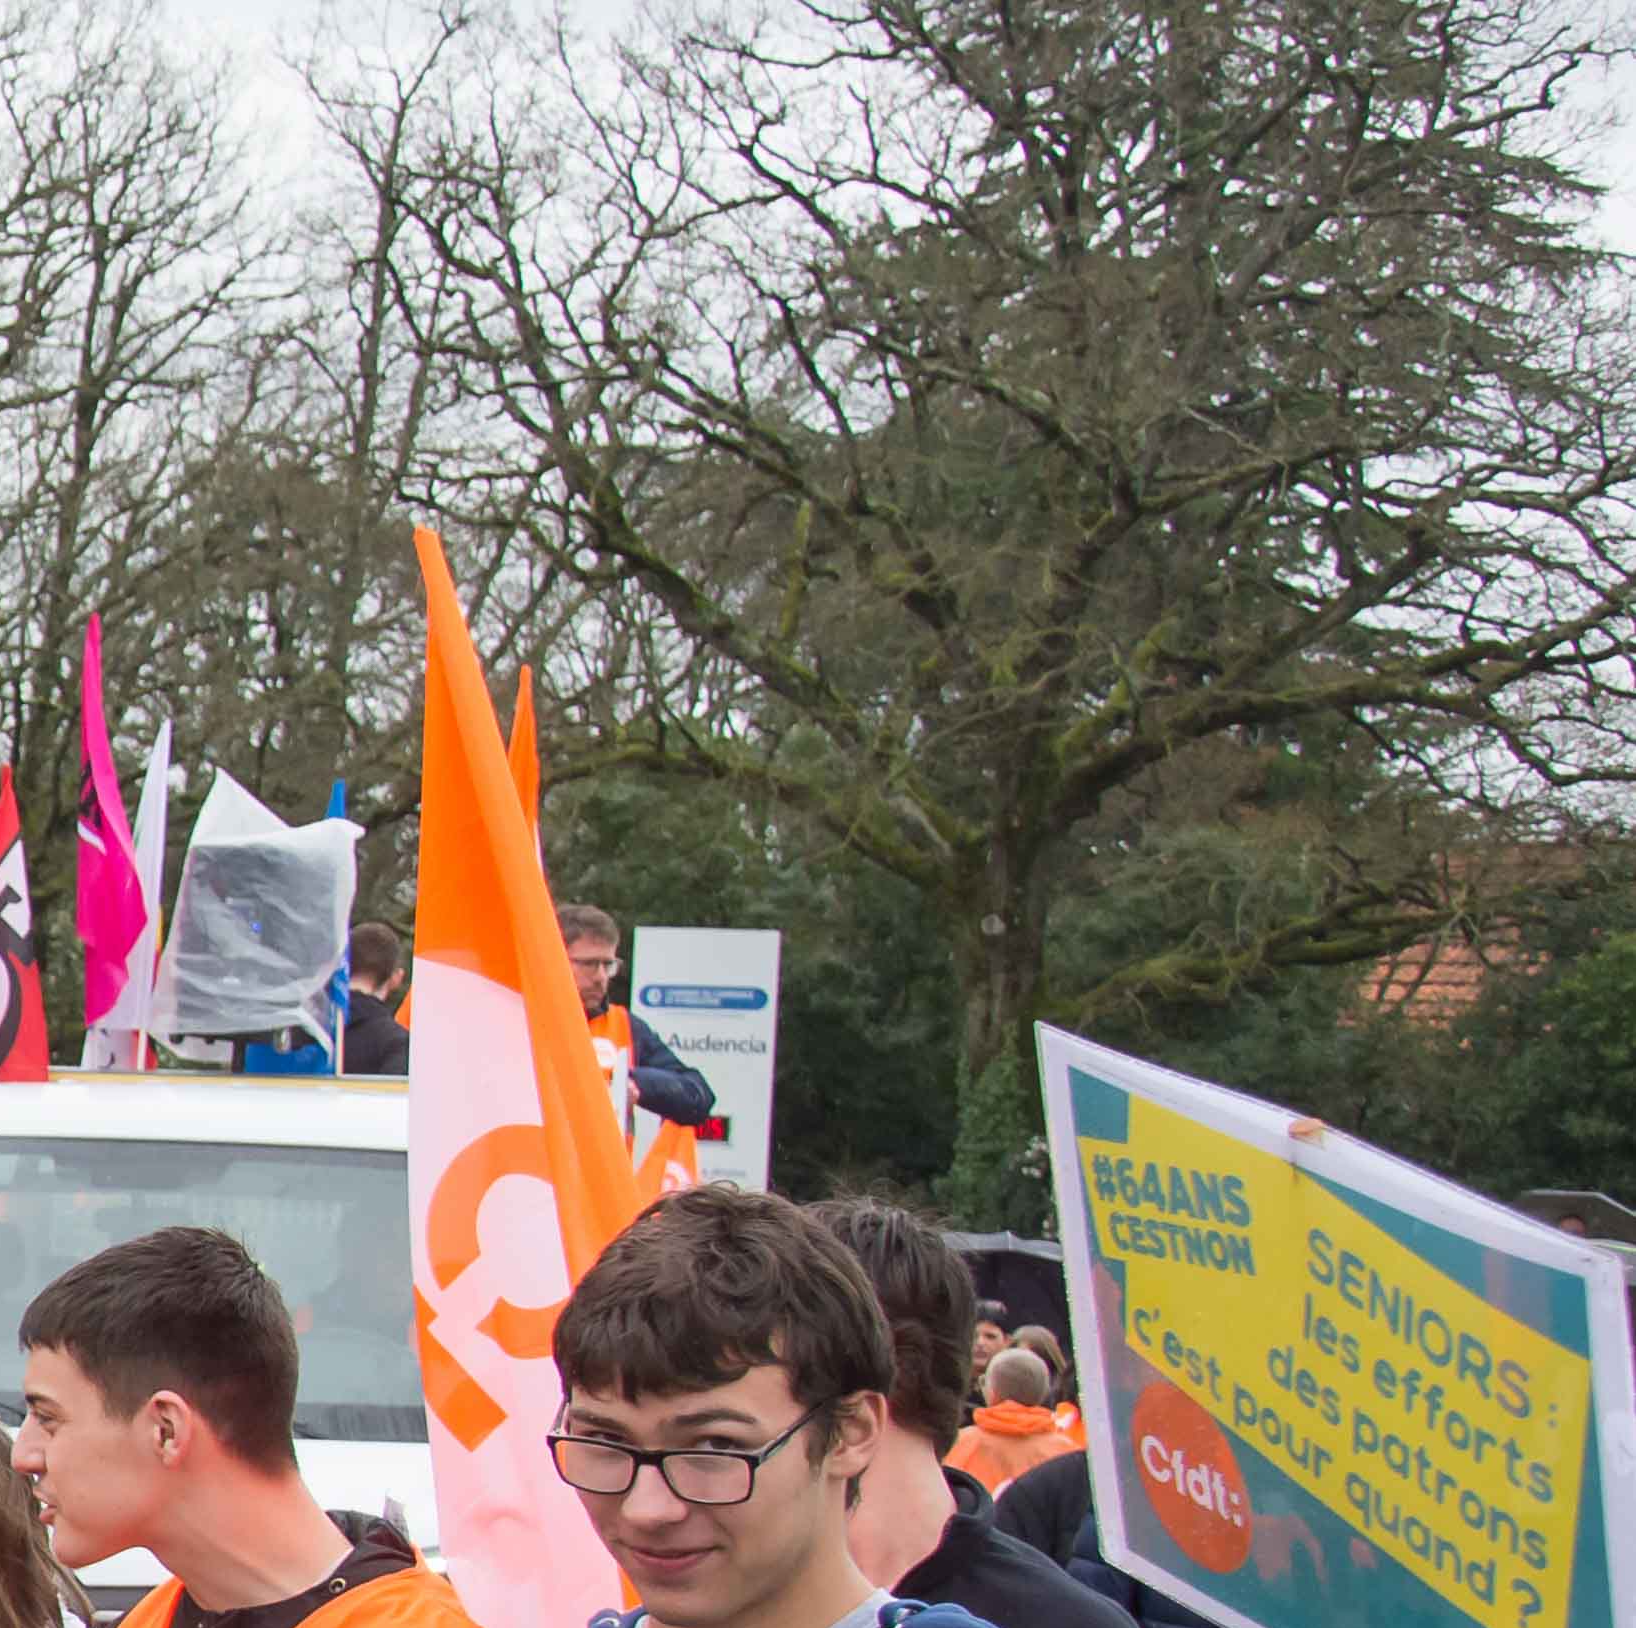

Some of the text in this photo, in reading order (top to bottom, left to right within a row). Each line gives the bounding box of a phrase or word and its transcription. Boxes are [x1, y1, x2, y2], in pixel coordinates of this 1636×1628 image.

[668, 1033, 766, 1054] Audencia
[1092, 1155, 1252, 1228] #64ANS
[1109, 1214, 1257, 1276] CESTNON
[1303, 1293, 1554, 1503] les efforts
[1133, 1307, 1224, 1403] c'est
[1233, 1382, 1334, 1480] pour
[1345, 1472, 1497, 1606] quand
[1140, 1435, 1244, 1529] Cfdt:
[1267, 1346, 1548, 1571] des patrons
